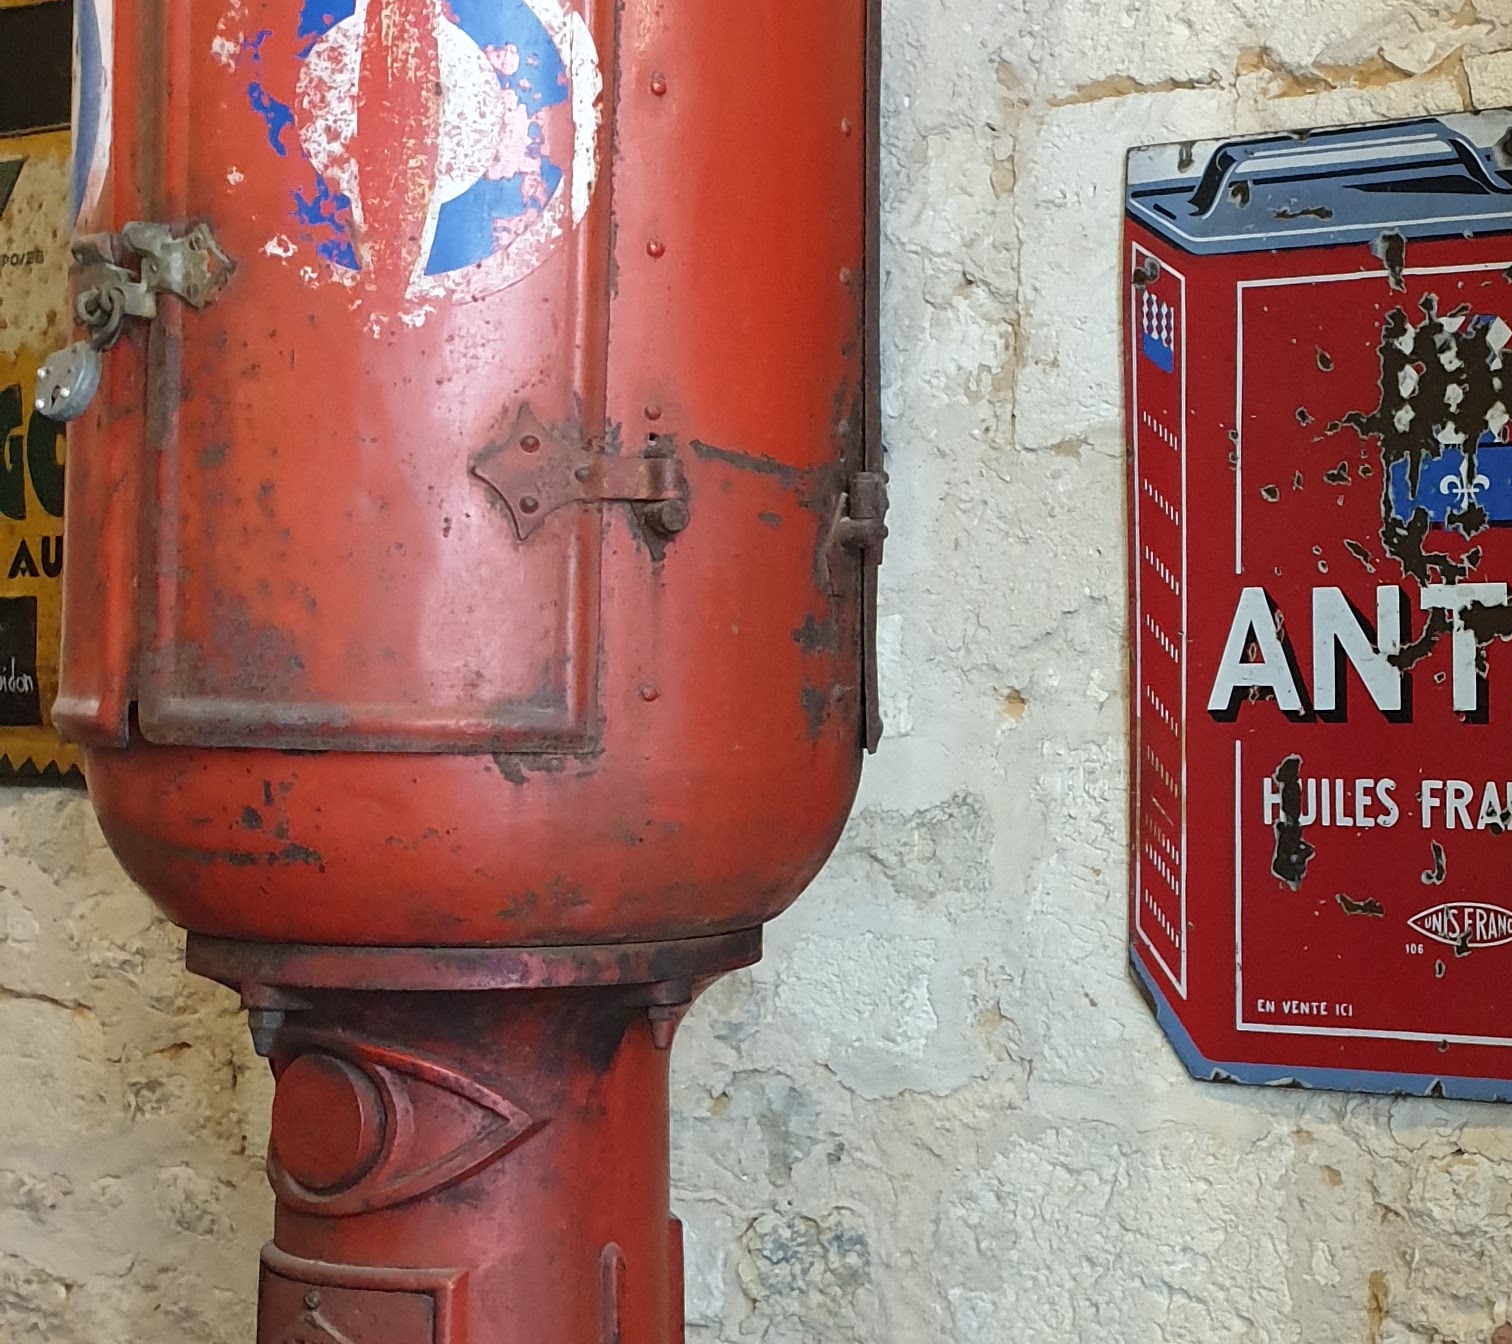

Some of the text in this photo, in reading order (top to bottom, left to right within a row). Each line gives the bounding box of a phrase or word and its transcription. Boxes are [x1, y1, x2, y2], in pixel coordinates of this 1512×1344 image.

[1262, 776, 1400, 829] HUILES
[1424, 907, 1460, 938] UNIS
[1404, 942, 1425, 956] 106
[1256, 998, 1354, 1018] EN VENTE ICI
